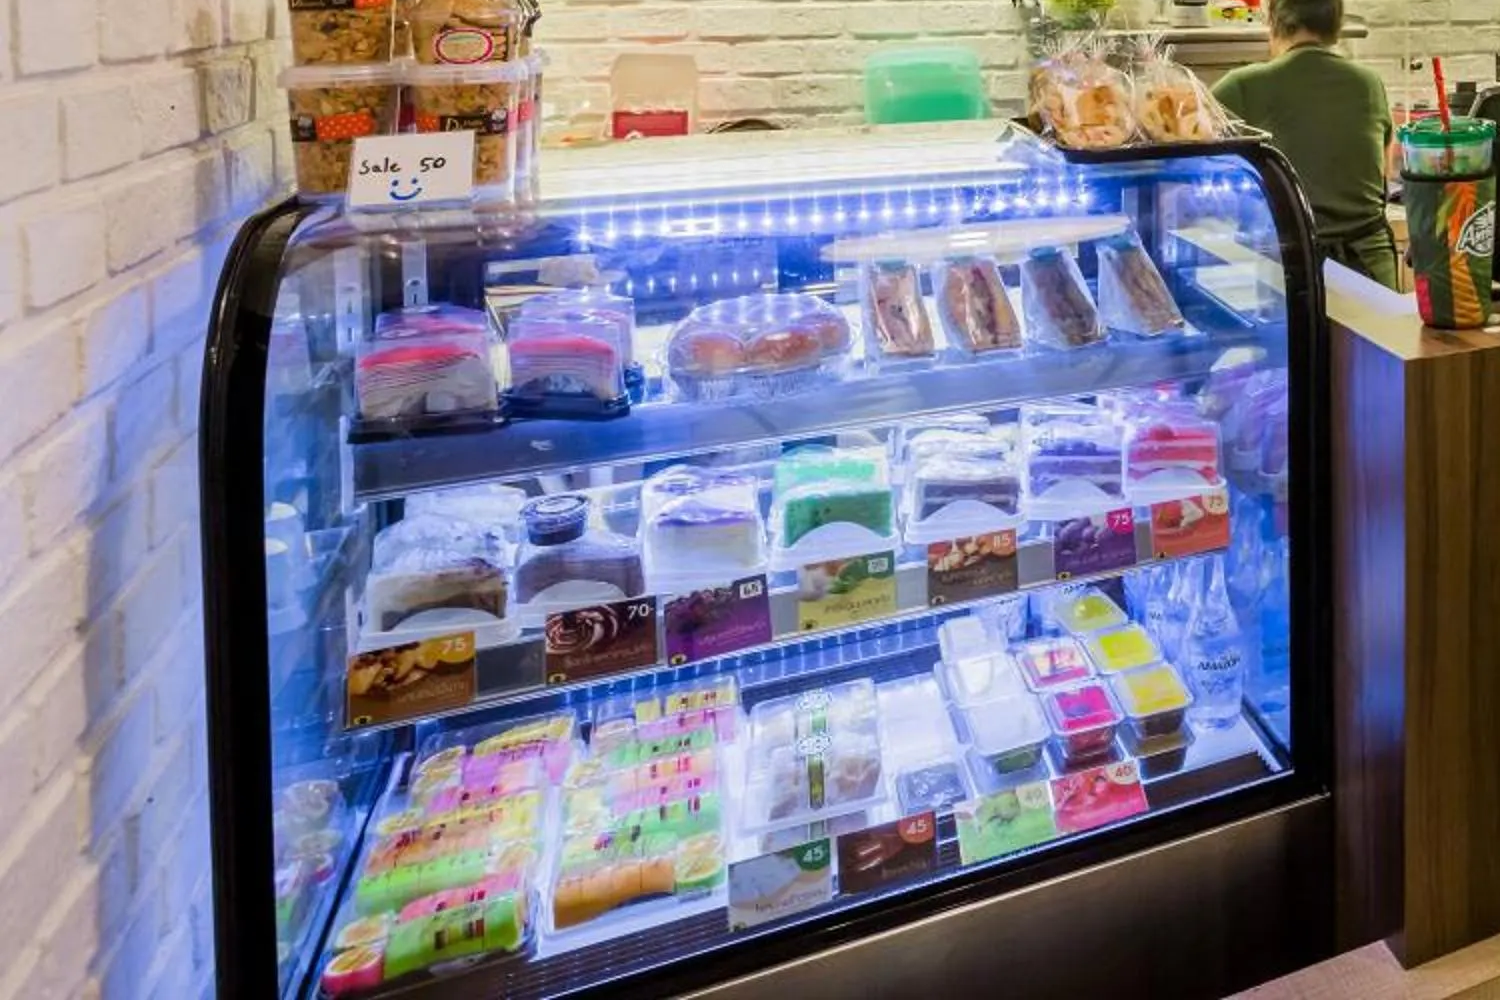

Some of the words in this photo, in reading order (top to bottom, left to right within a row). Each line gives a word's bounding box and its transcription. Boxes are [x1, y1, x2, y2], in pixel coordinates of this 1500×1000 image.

[359, 157, 402, 175] Sale
[419, 157, 447, 173] 50
[1113, 511, 1131, 527] 75
[627, 603, 650, 620] 70
[442, 638, 467, 655] 75
[906, 819, 928, 835] 45
[803, 847, 825, 863] 45
